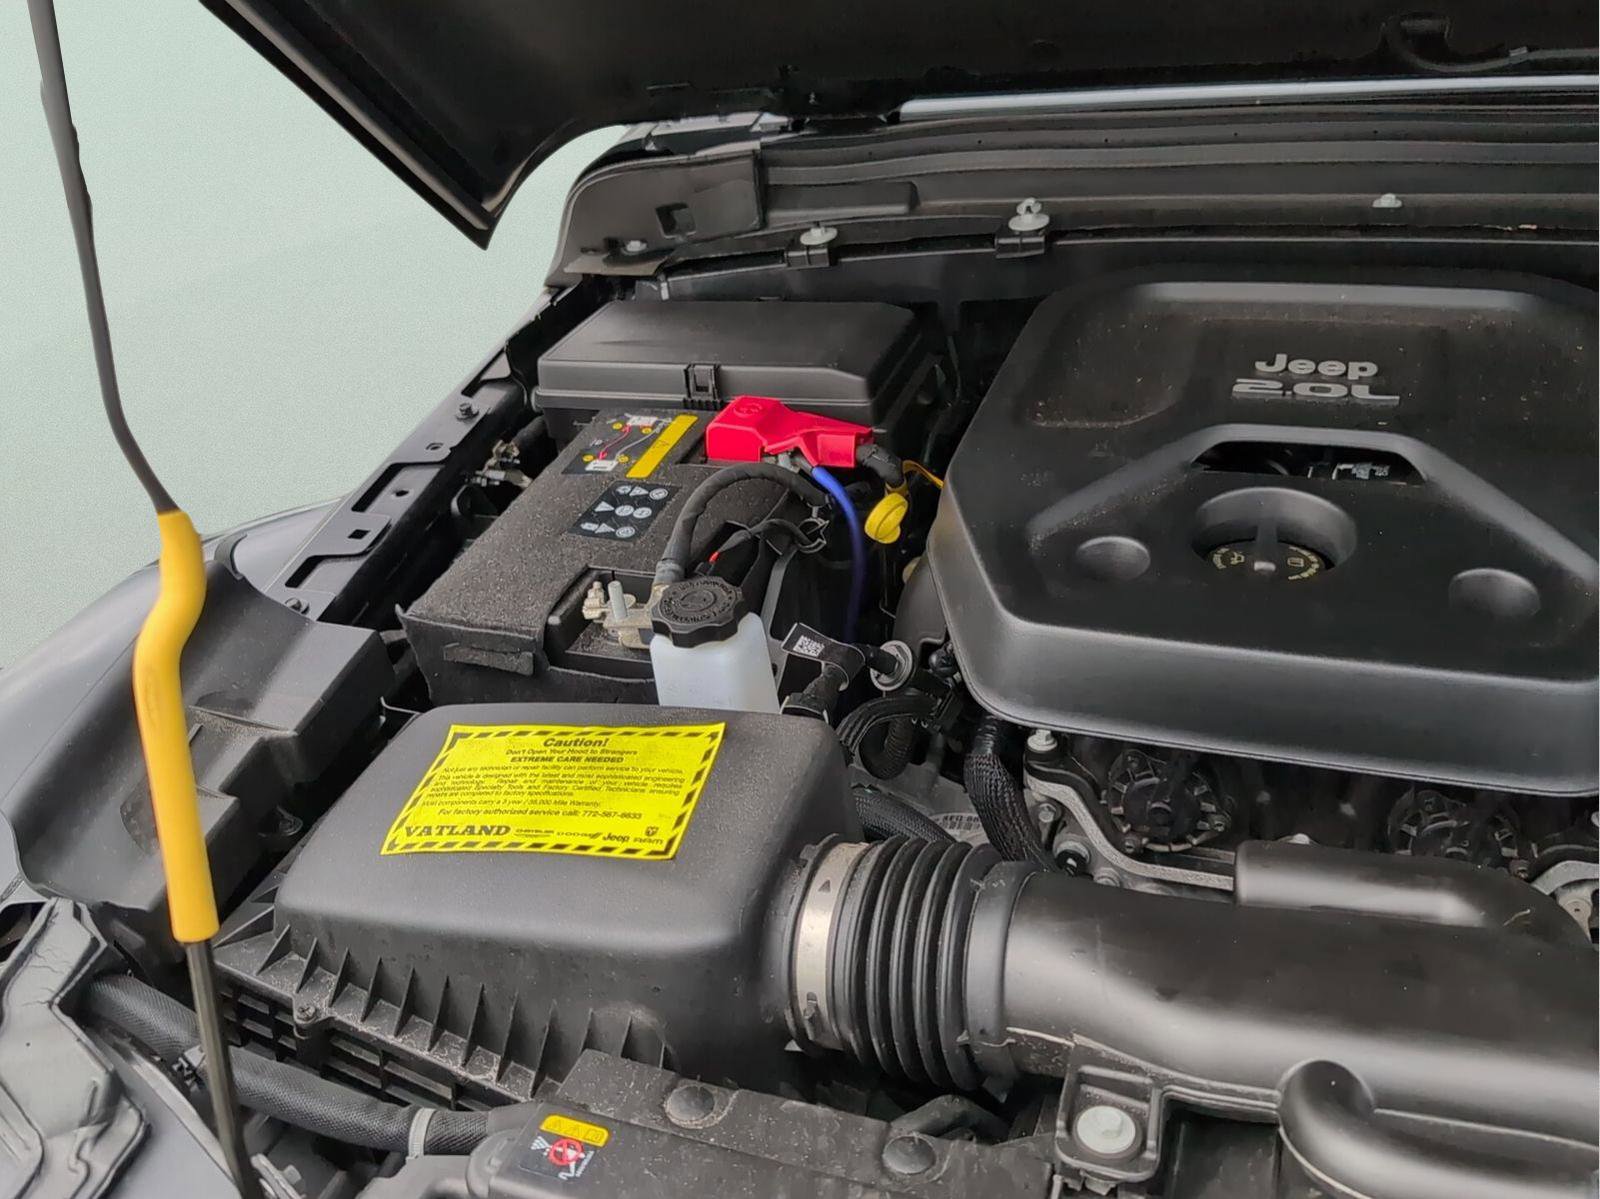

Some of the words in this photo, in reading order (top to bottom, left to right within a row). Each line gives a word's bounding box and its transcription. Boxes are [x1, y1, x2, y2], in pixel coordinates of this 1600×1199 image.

[1255, 353, 1328, 380] Jeep
[1232, 378, 1400, 400] 2.0L
[543, 737, 610, 747] Caution!
[438, 808, 452, 816] For
[453, 808, 482, 816] factory
[482, 807, 529, 816] authorized
[528, 808, 561, 816] service
[405, 824, 512, 837] VATLAND
[602, 833, 630, 843] Jeep
